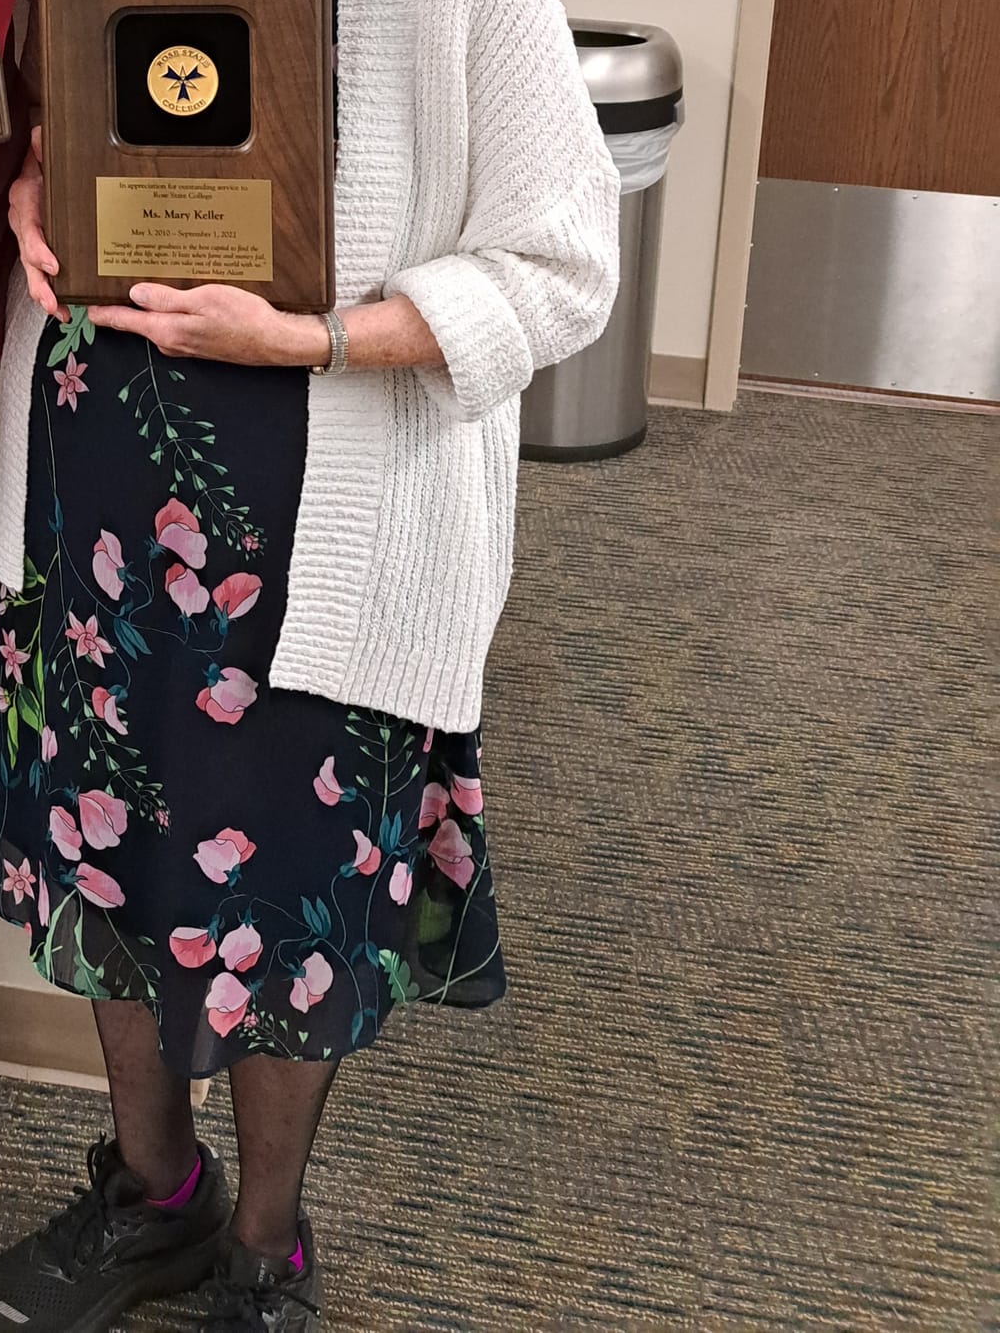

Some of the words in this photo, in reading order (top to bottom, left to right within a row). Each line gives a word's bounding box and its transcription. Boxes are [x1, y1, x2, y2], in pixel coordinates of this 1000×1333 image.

[156, 49, 180, 68] ROSE
[182, 49, 212, 69] STATE
[162, 98, 207, 113] COLLEGE
[127, 182, 167, 191] appreciation
[167, 182, 177, 190] for
[178, 183, 216, 192] outstanding
[153, 191, 169, 199] Rose
[188, 192, 213, 201] College
[142, 208, 161, 219] Ms.
[164, 209, 190, 222] Mary
[194, 209, 225, 221] Keller
[131, 229, 146, 237] May
[178, 230, 212, 240] September
